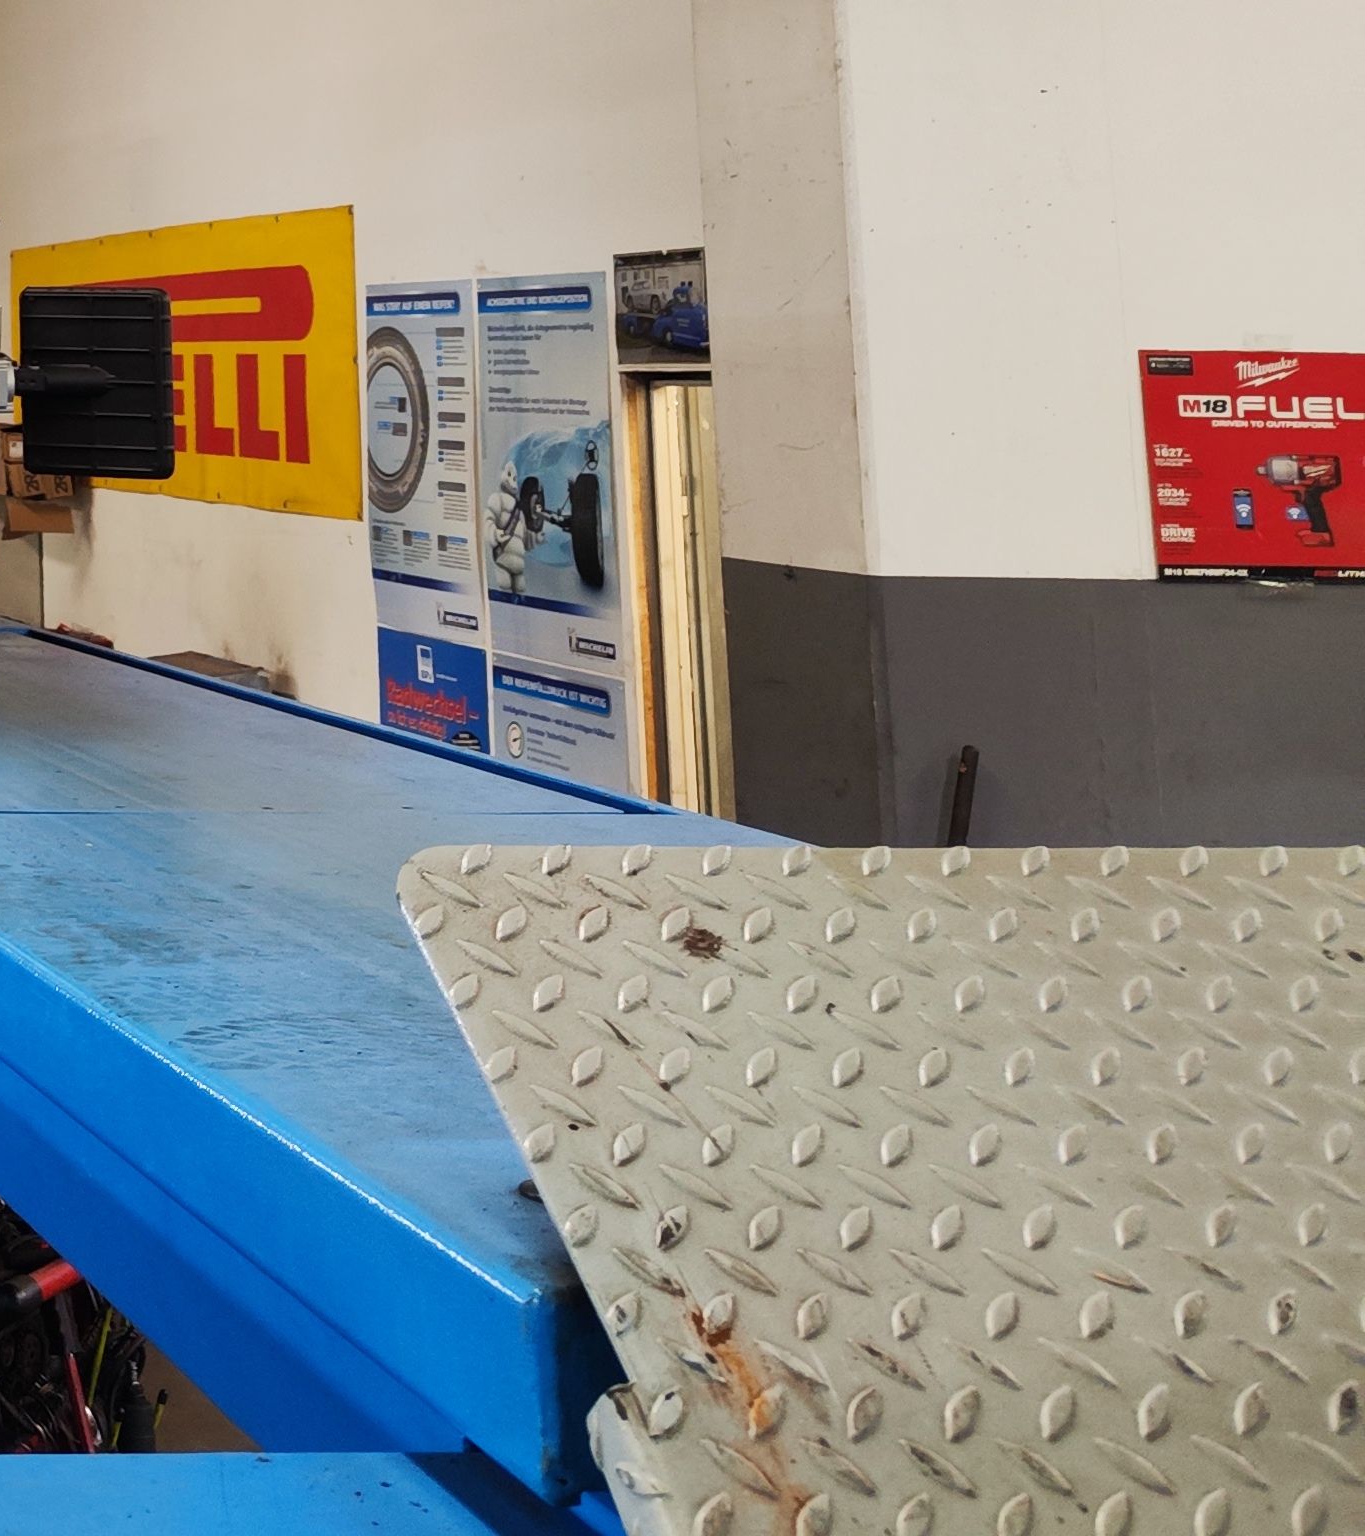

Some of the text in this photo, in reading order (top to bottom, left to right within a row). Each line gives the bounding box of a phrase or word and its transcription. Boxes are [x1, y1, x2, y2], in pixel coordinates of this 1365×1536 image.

[1234, 356, 1300, 381] Milwaukee
[1182, 395, 1365, 420] M18 FUEL
